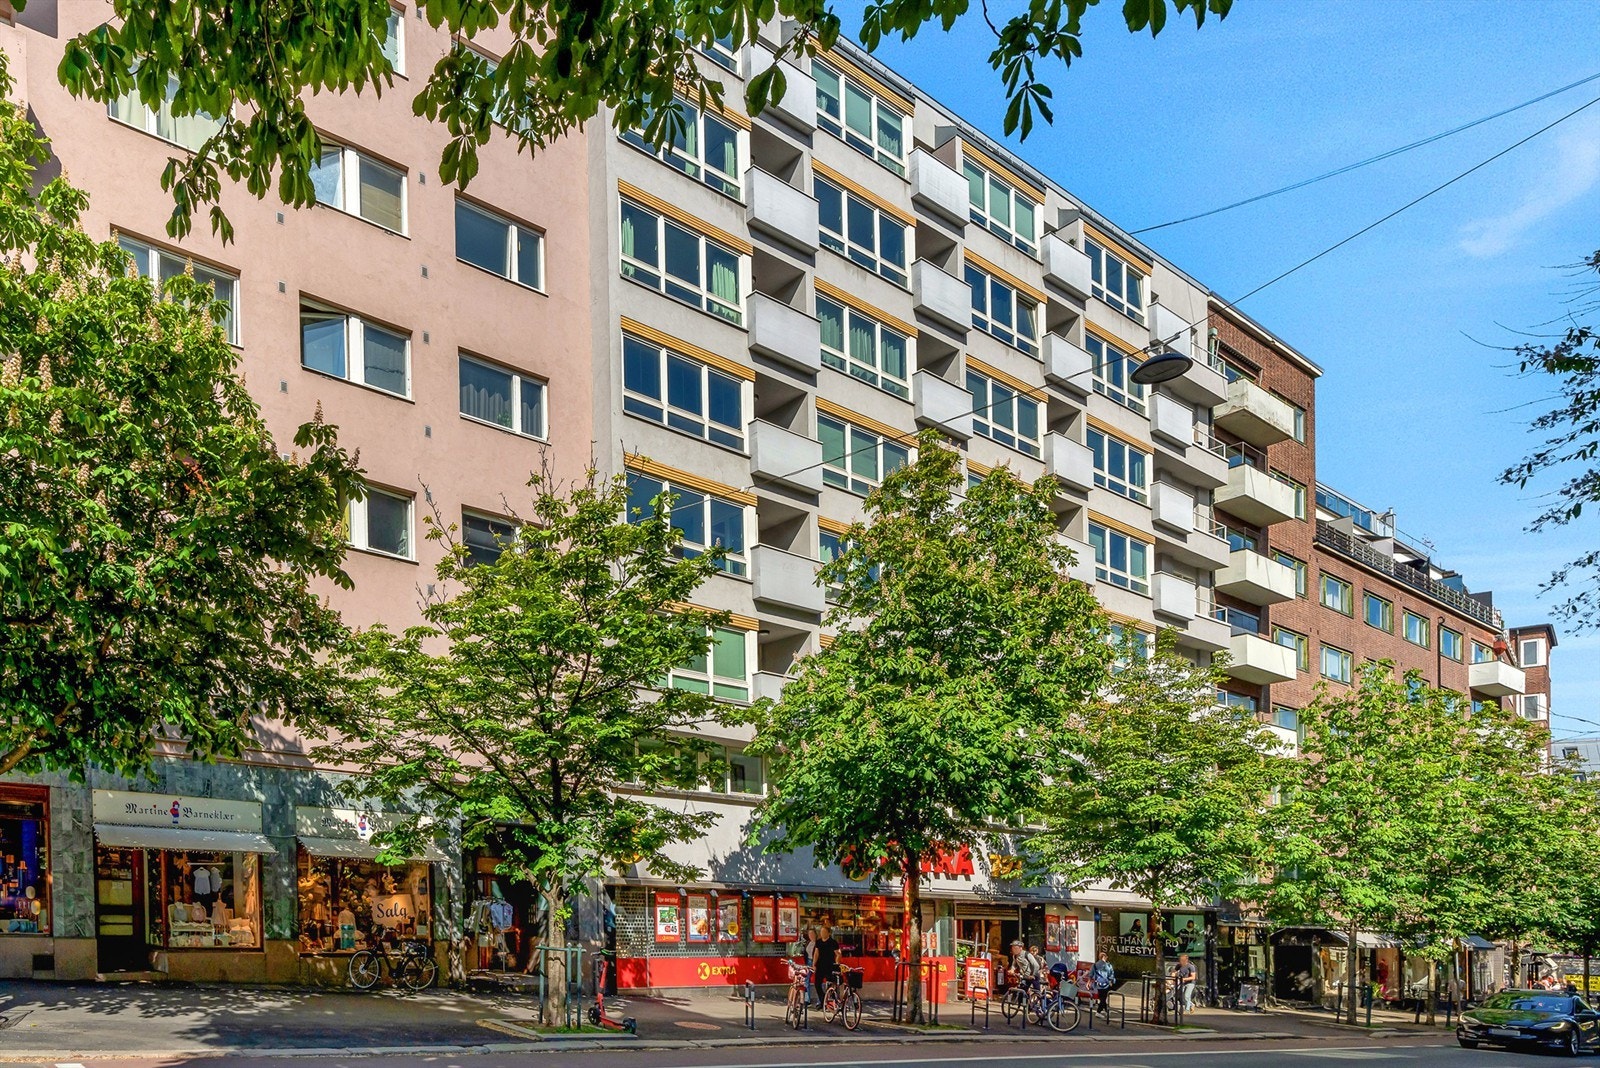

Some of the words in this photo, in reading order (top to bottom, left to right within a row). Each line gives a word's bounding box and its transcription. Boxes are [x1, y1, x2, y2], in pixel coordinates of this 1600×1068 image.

[124, 802, 168, 816] Martine
[182, 806, 235, 820] Barneklær
[1119, 936, 1144, 946] THAN
[1109, 945, 1116, 953] A
[1116, 945, 1157, 956] LIFESTYL
[712, 966, 737, 975] EXTRA
